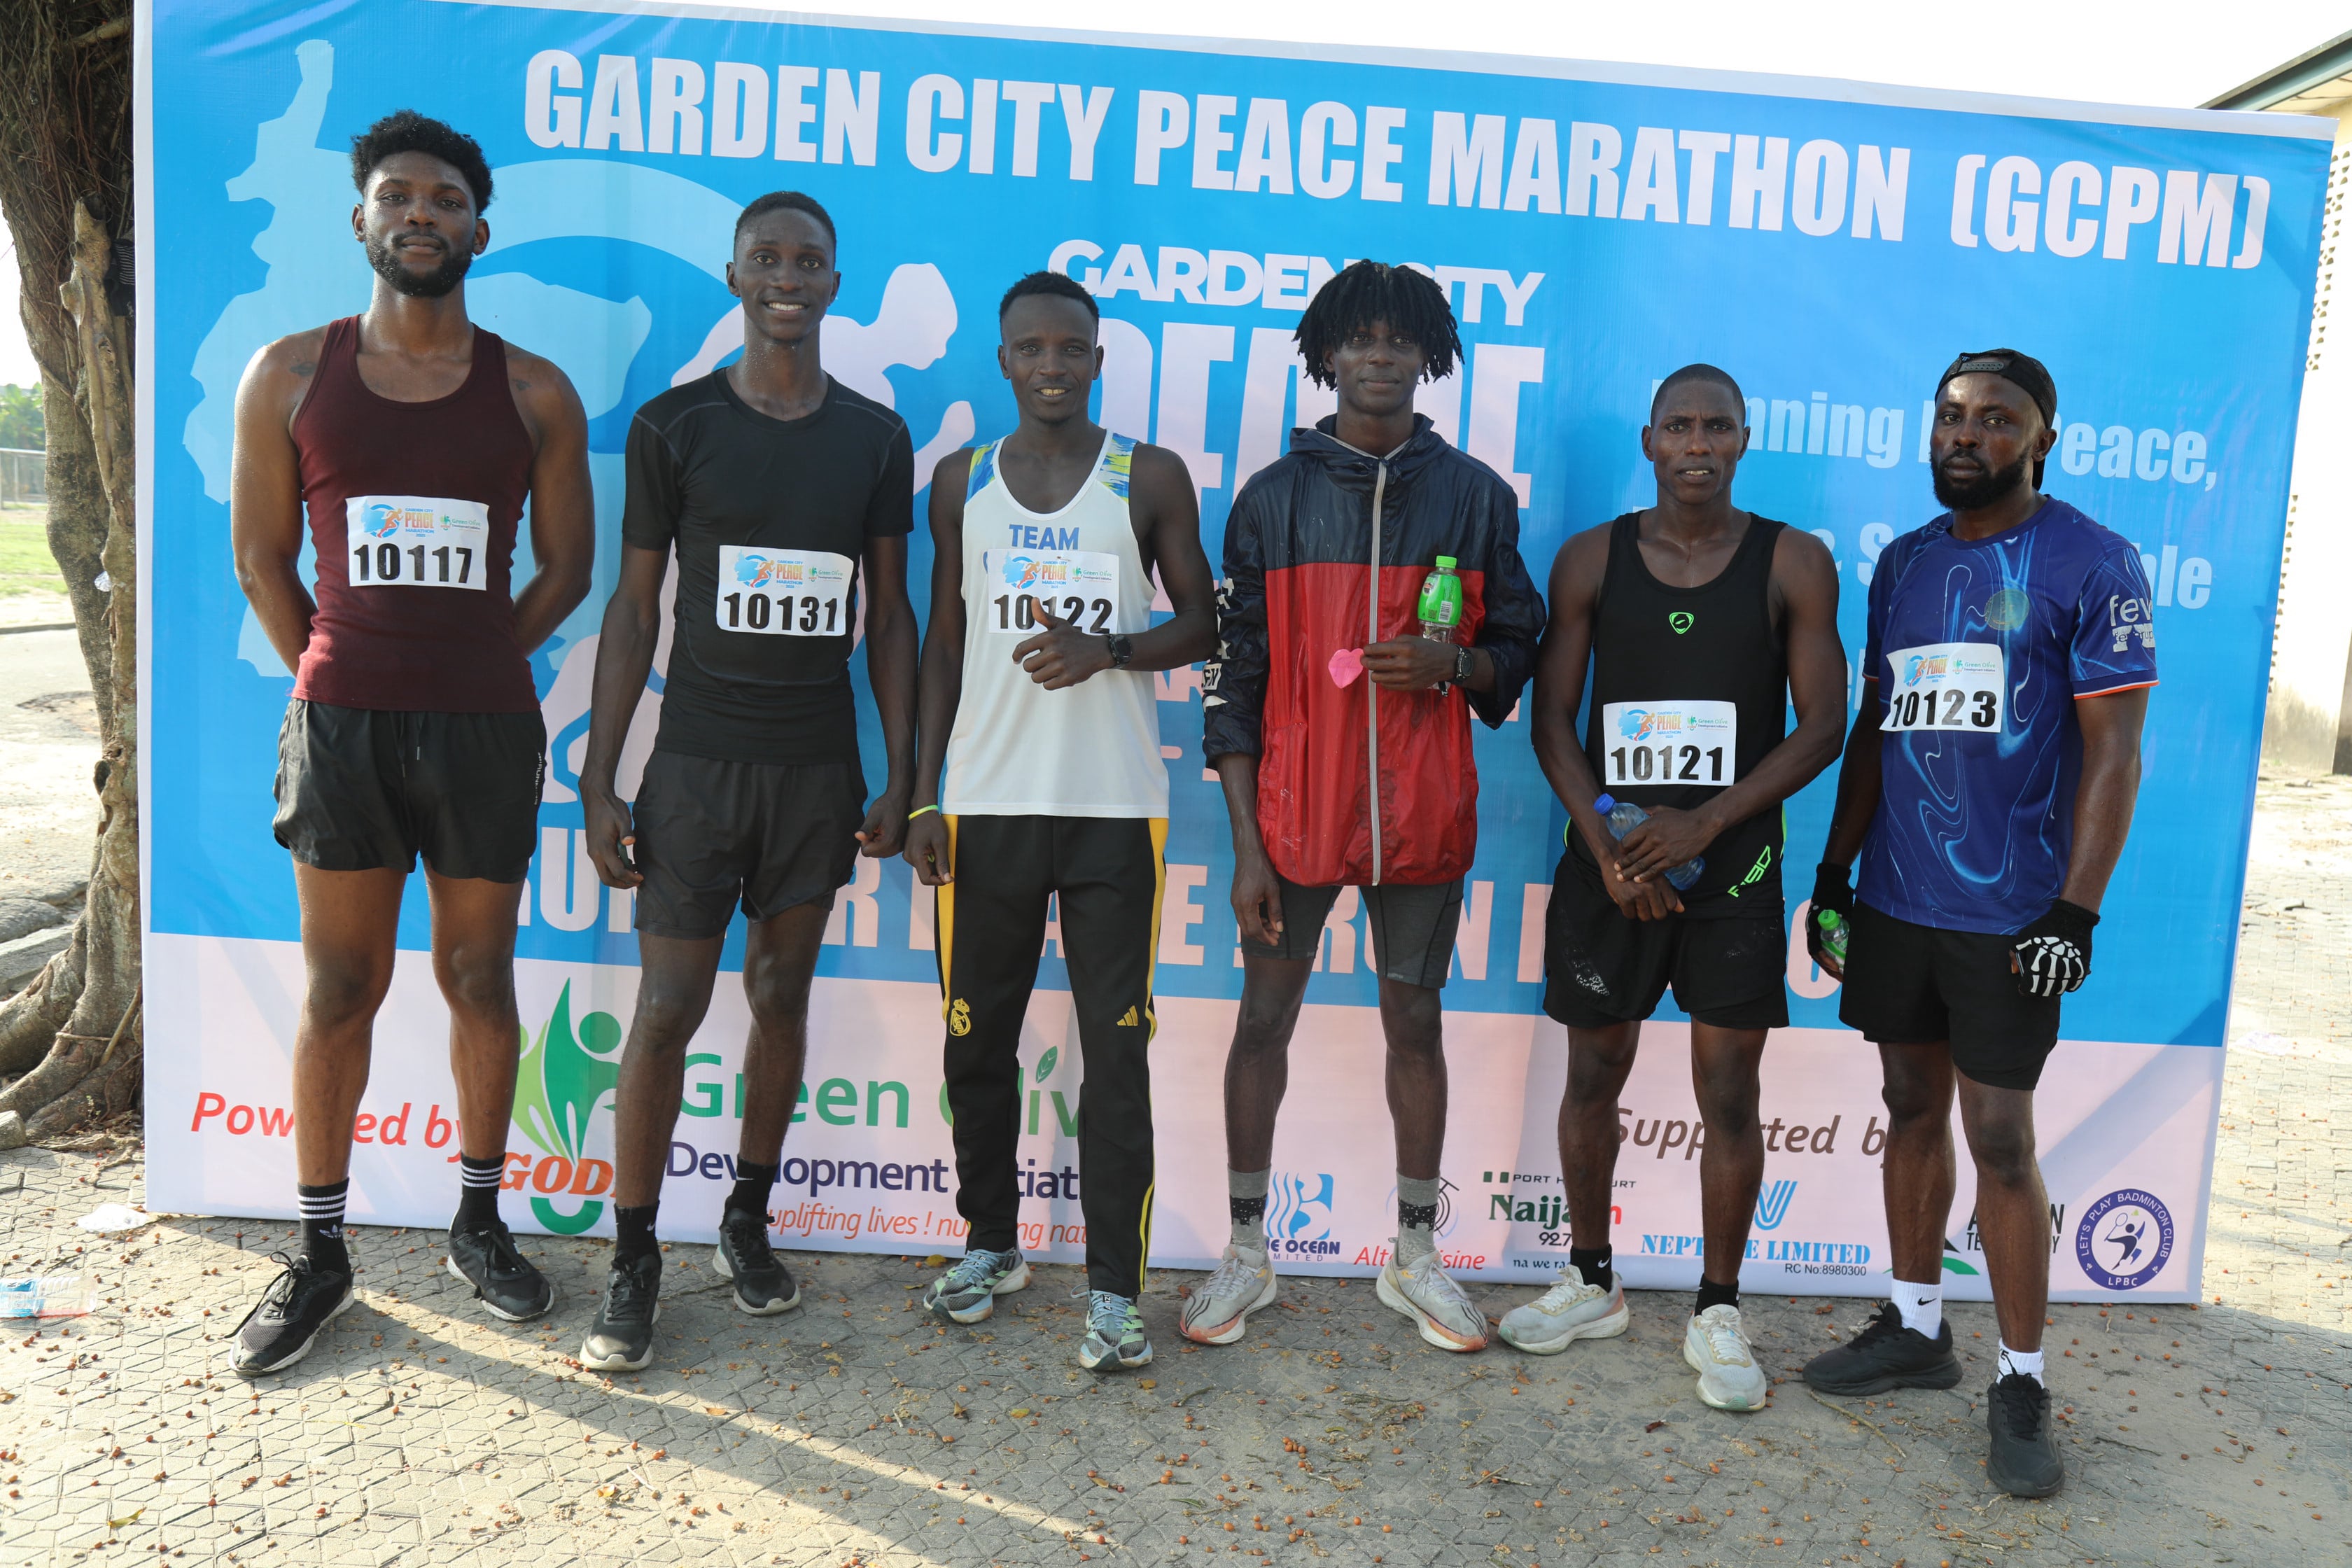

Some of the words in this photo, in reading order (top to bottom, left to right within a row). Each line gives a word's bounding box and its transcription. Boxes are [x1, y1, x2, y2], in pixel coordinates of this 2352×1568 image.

[524, 50, 881, 167] GARDEN
[905, 73, 1114, 182] CITY
[1134, 89, 1406, 203] PEACE
[1427, 111, 1910, 242] MARATHON
[1394, 262, 1546, 326] ITY
[405, 512, 434, 528] PEACE
[1009, 524, 1079, 550] TEAM
[354, 542, 472, 583] 10117
[776, 564, 803, 580] PEACE
[1042, 565, 1067, 580] PEACE
[724, 592, 837, 632] 10131
[994, 594, 1112, 634] 10122
[1927, 659, 1947, 675] PEACE
[1658, 715, 1681, 730] PEACE
[1891, 689, 1997, 728] 10123
[1611, 745, 1723, 781] 10121
[191, 1092, 412, 1147] Powed
[1618, 1107, 1841, 1161] Suppted
[499, 1152, 616, 1198] GOD
[1513, 1173, 1551, 1183] PORT
[769, 1202, 862, 1239] uplifting
[867, 1206, 918, 1235] lives
[2080, 1224, 2091, 1256] LET'S
[2088, 1198, 2112, 1222] PLAY
[2118, 1192, 2170, 1226] BADMINTON
[2160, 1228, 2172, 1258] CLUB
[1285, 1239, 1340, 1255] OCEAN
[1513, 1259, 1528, 1268] na
[1533, 1260, 1550, 1268] we
[1640, 1234, 1759, 1259] NEPTE
[1767, 1240, 1870, 1264] LIMITED
[1785, 1264, 1801, 1273] RC
[1805, 1264, 1866, 1276] No:8980300
[2108, 1277, 2138, 1286] LPBC
